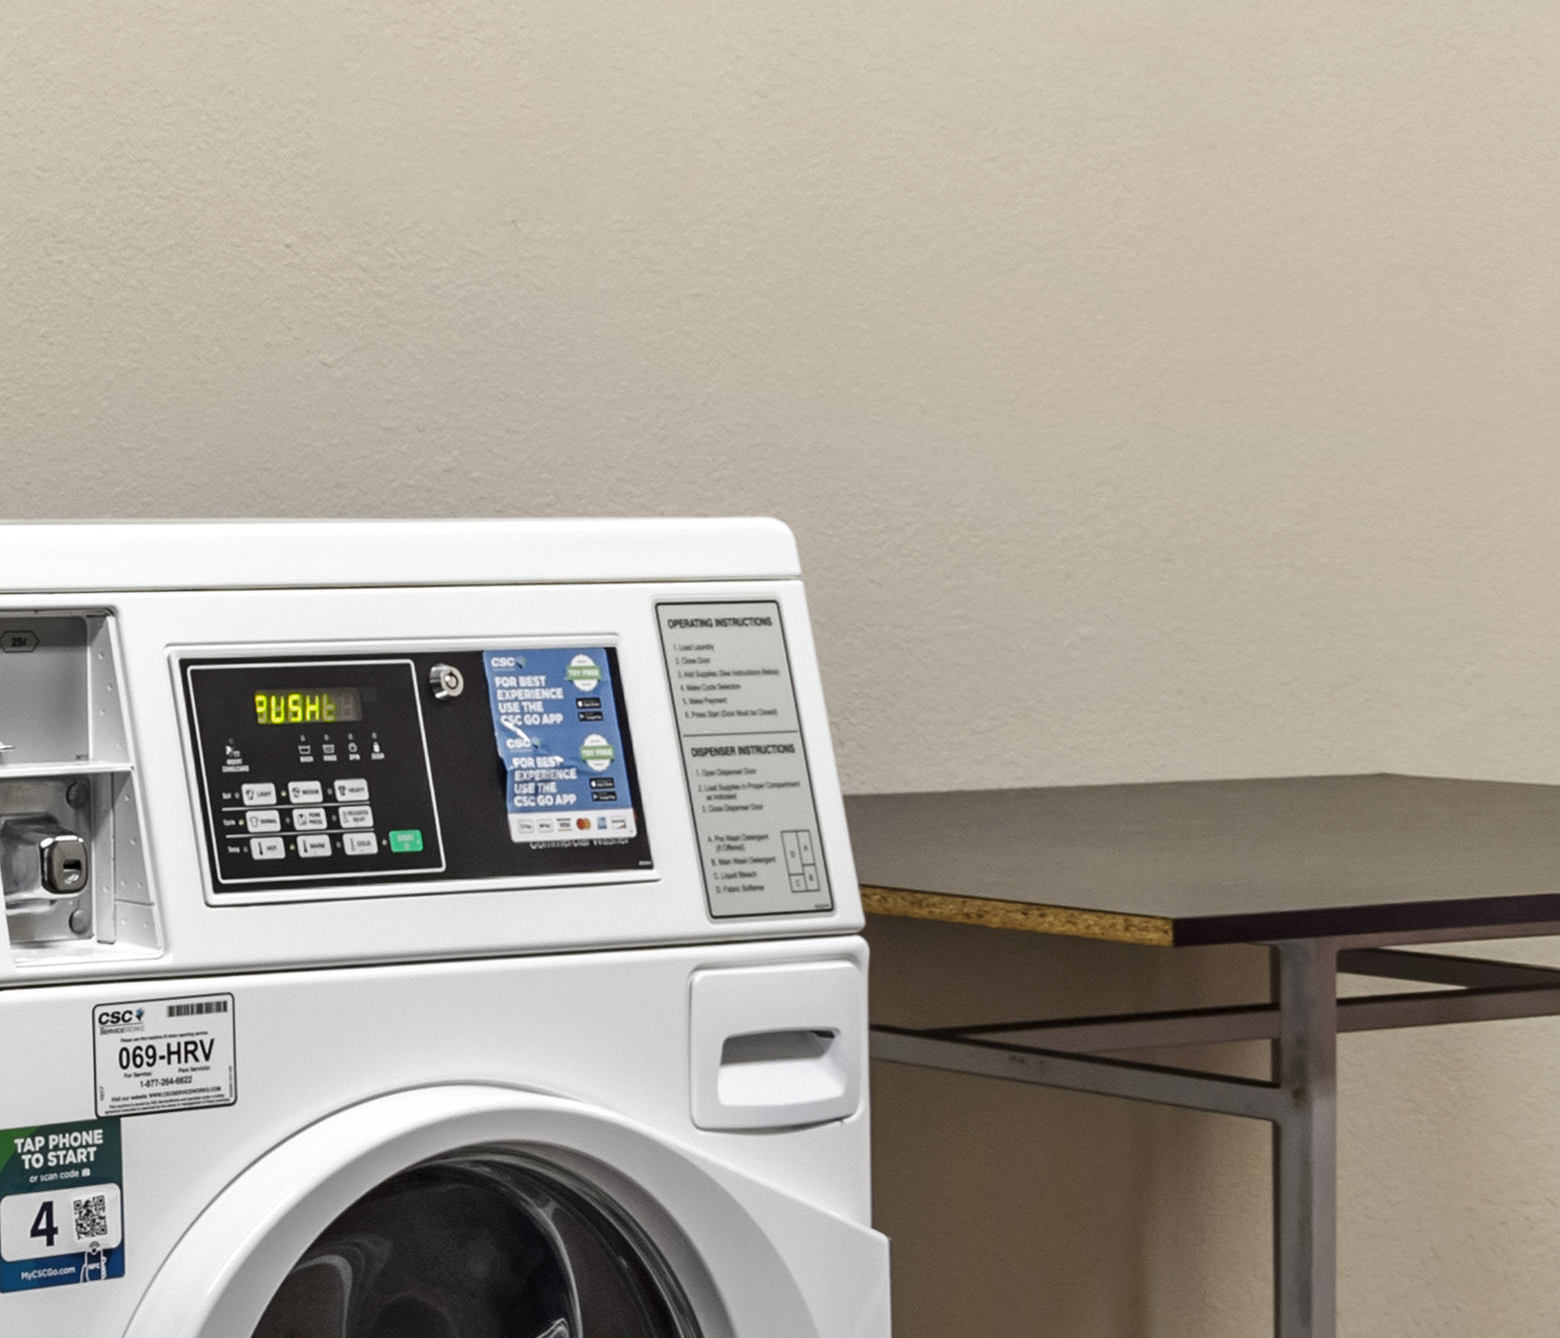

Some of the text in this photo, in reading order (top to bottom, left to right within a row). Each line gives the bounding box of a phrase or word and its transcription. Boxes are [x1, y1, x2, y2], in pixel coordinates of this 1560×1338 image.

[667, 616, 773, 630] OPERATING INSTRUCTIONS
[490, 656, 515, 668] CSC
[494, 675, 547, 689] FOR BEST
[496, 688, 564, 701] EXPERIENCE
[498, 701, 544, 713] USE THE
[524, 713, 541, 725] GO
[542, 712, 564, 725] APP
[690, 743, 796, 758] DISPENSER INSTRUCTIONS
[97, 1009, 133, 1026] CSC
[118, 1038, 215, 1070] 069-HRV
[13, 1129, 104, 1154] TAP PHONE
[20, 1147, 98, 1169] TO START
[29, 1200, 59, 1248] 4
[20, 1265, 77, 1281] MyCSCGo.com
